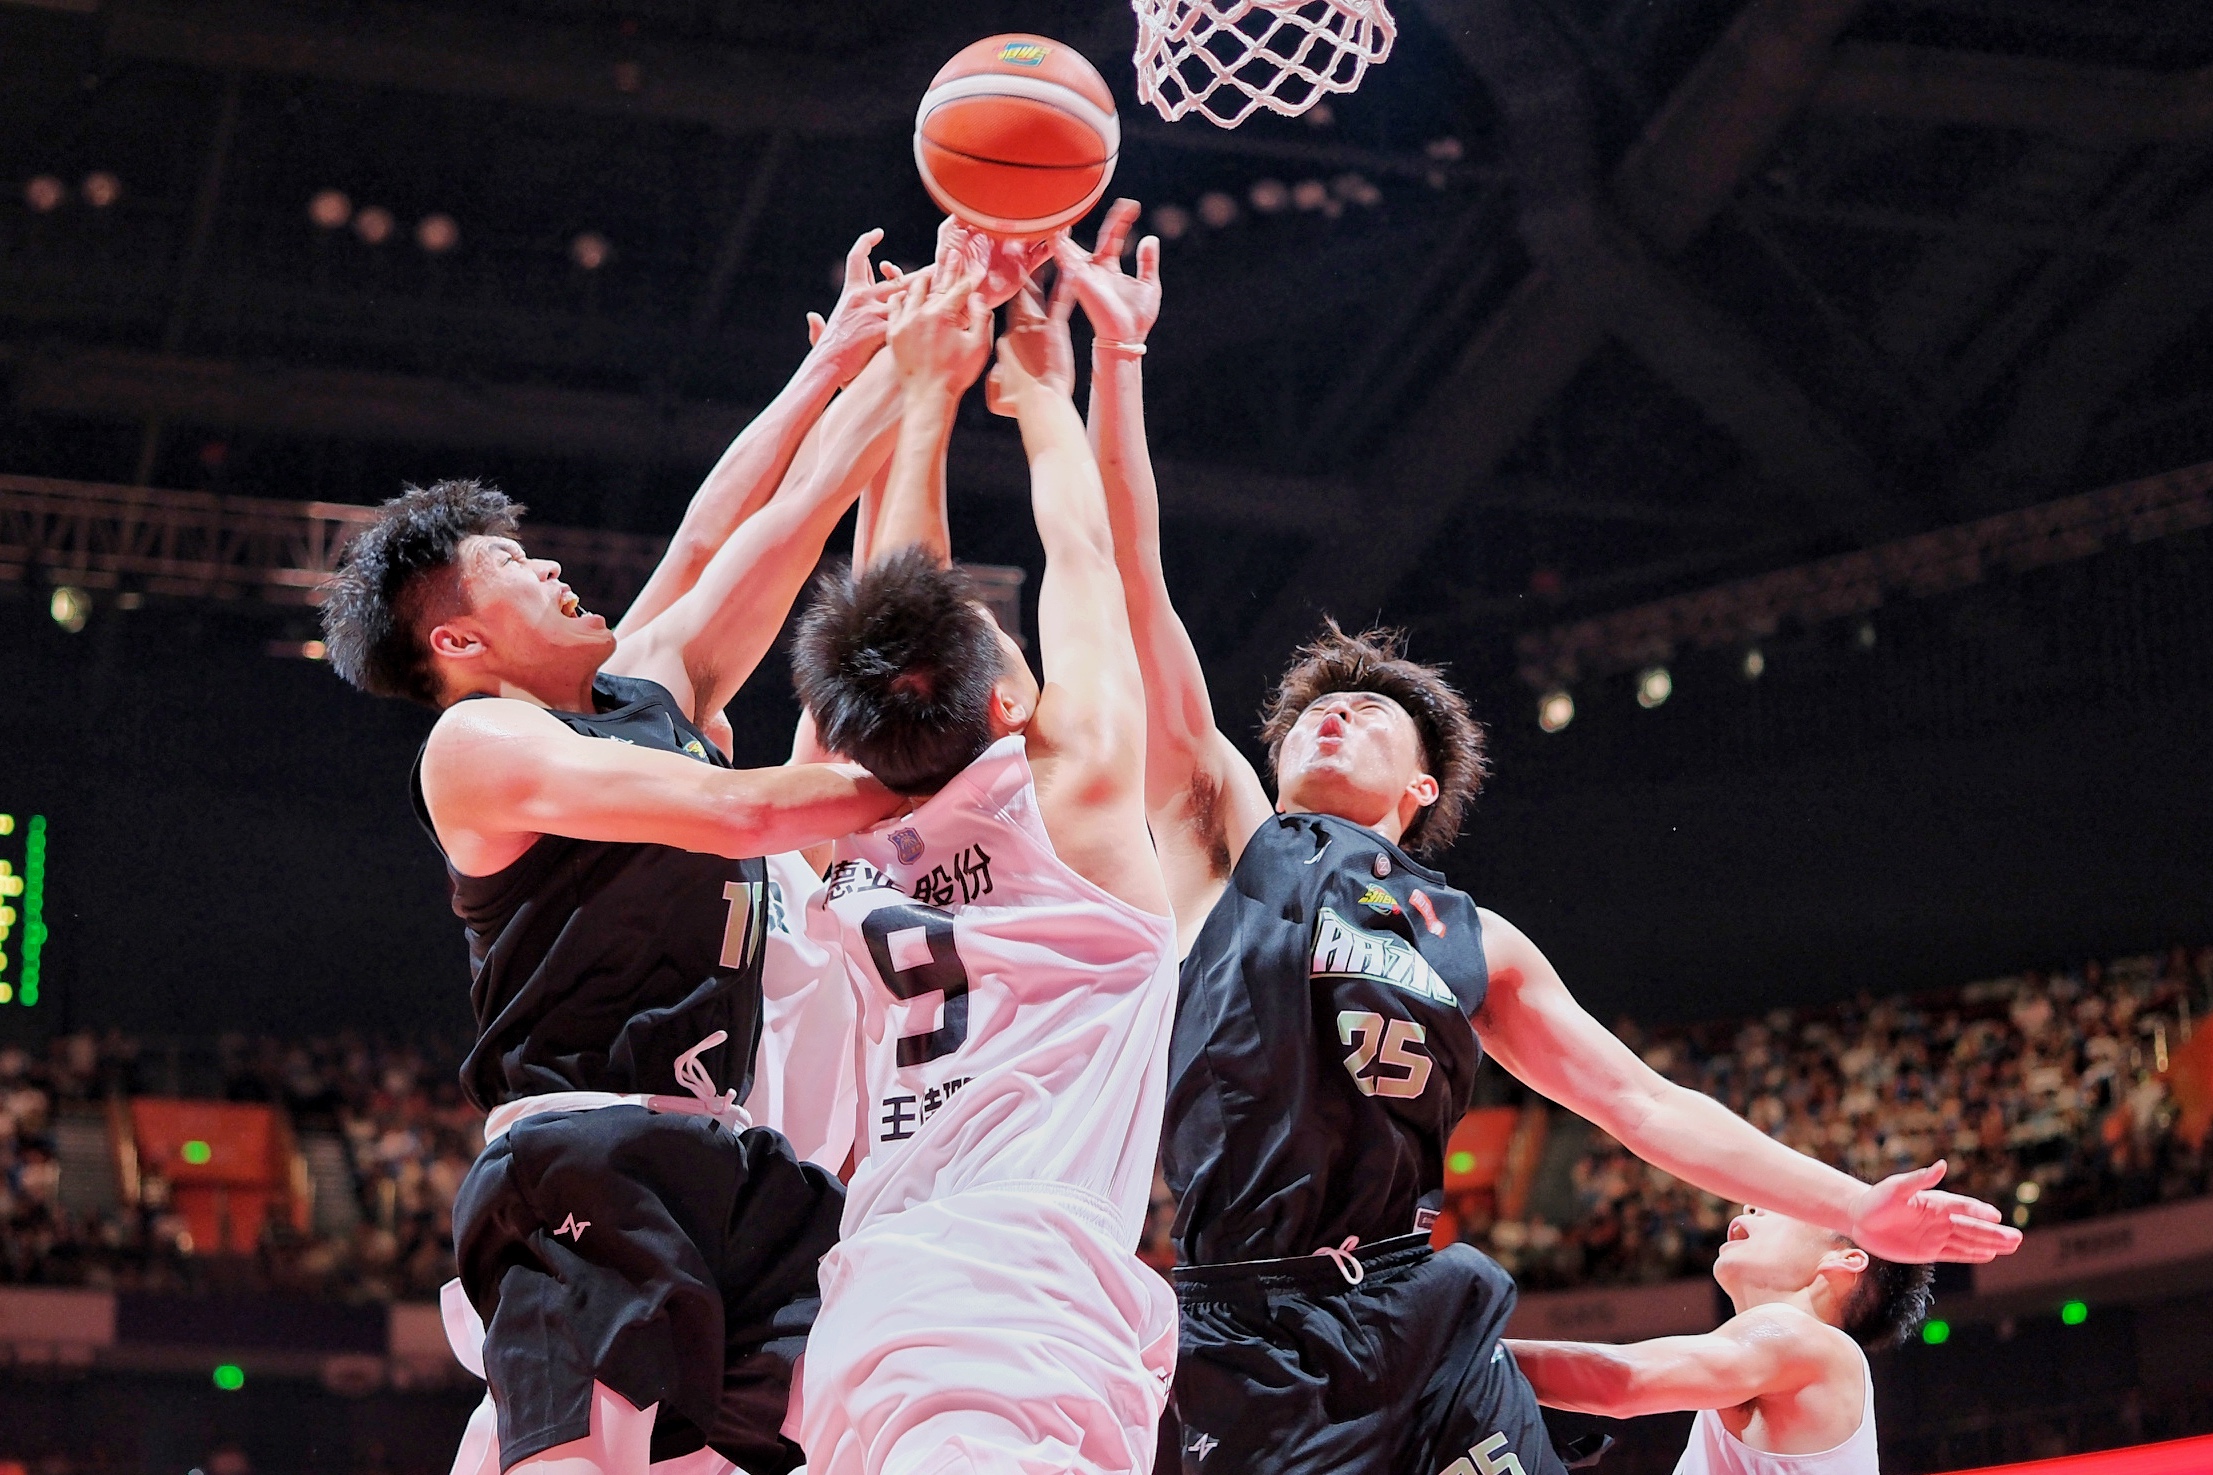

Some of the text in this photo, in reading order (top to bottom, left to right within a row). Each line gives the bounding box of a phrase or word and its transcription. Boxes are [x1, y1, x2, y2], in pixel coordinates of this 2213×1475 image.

[861, 904, 970, 1068] 9
[1337, 1010, 1433, 1099] 25
[880, 1077, 978, 1142] 王佳
